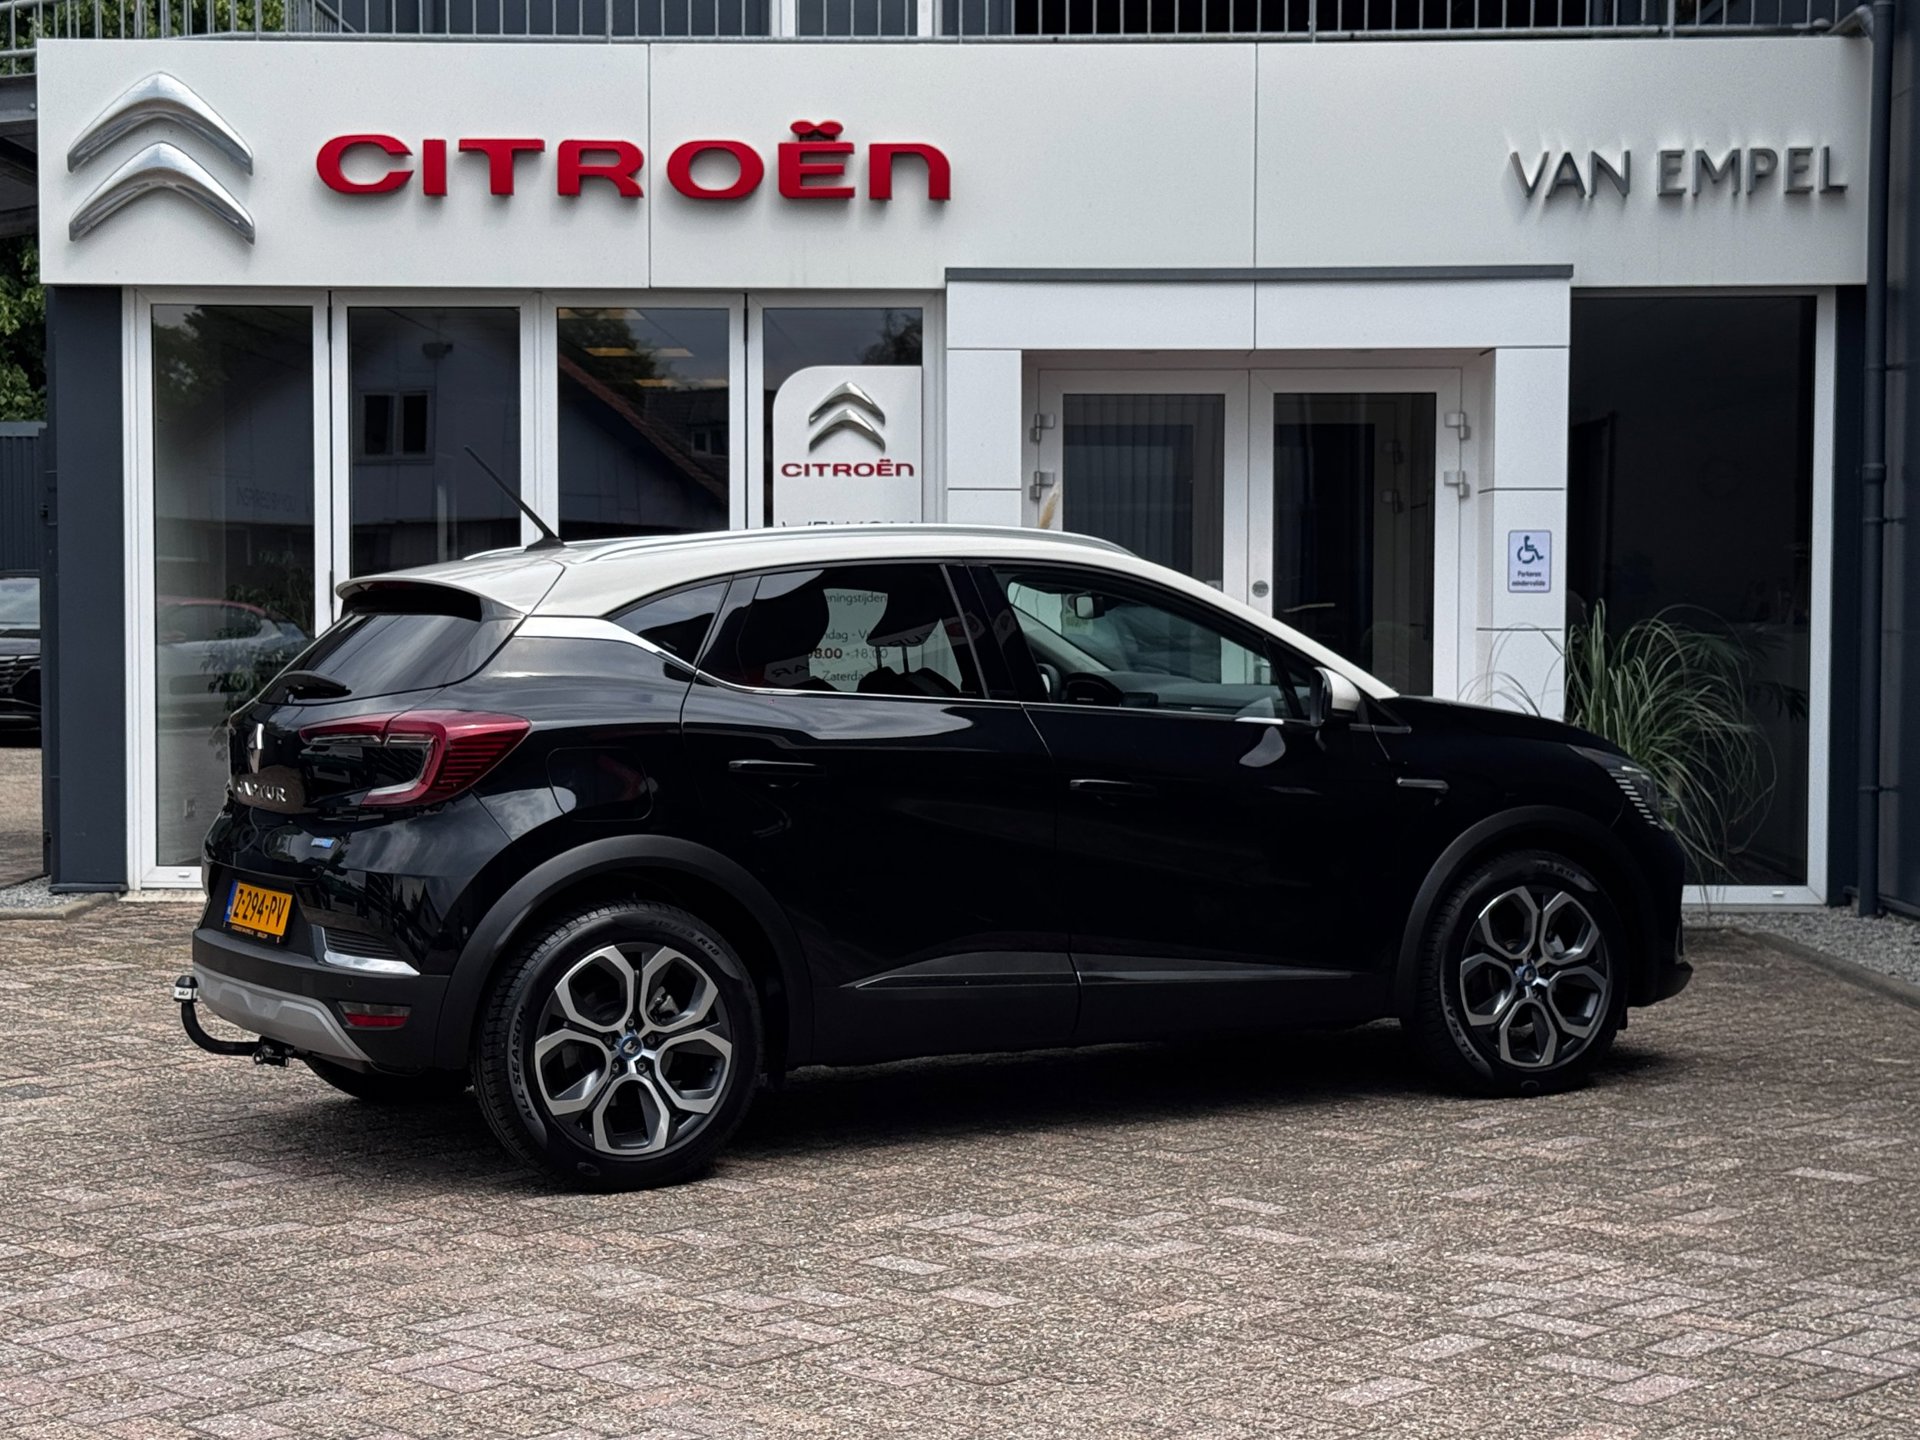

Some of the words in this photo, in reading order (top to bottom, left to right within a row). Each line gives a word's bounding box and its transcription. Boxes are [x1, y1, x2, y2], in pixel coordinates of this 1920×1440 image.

[1509, 149, 1631, 199] VAN
[1656, 146, 1849, 198] EMPEL
[822, 670, 864, 682] Zaterda
[233, 888, 287, 928] Z-294-PV
[511, 1005, 526, 1086] SEASON
[517, 1089, 536, 1121] ALL
